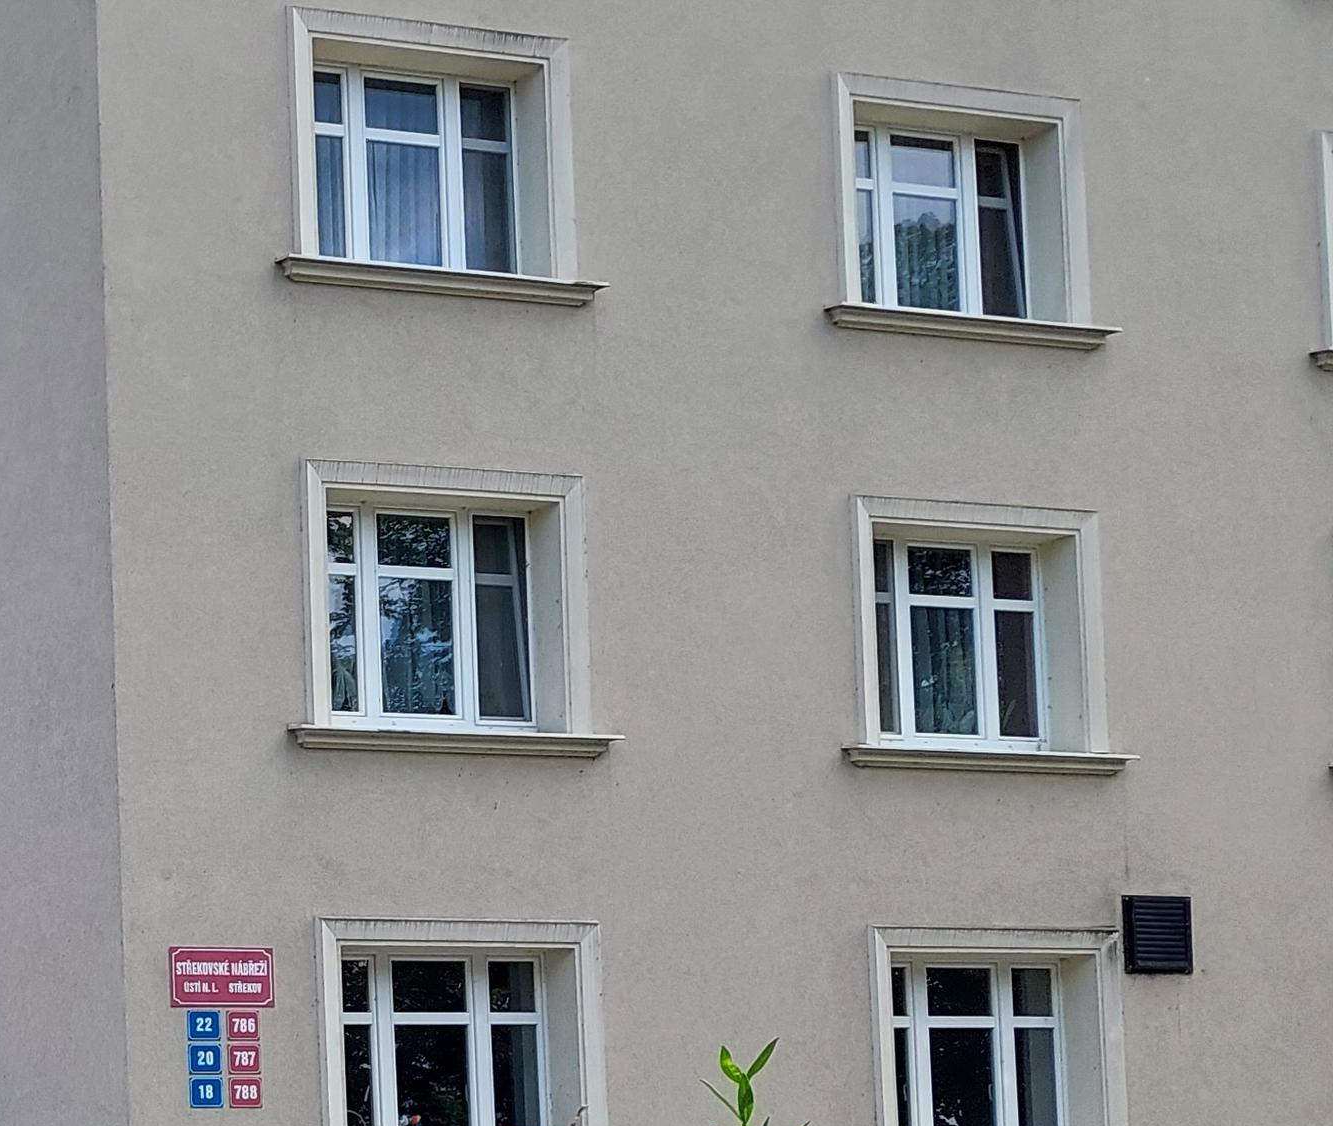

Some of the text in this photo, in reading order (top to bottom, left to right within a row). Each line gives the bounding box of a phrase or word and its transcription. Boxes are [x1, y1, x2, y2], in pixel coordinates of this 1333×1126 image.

[176, 959, 268, 976] STŘEKOVSKÉ NÁBŘEŽÍ
[228, 980, 262, 993] STŘEKOV
[195, 1017, 213, 1032] 22
[232, 1018, 256, 1033] 786
[197, 1051, 214, 1066] 20
[233, 1051, 256, 1067] 787
[198, 1085, 214, 1100] 18
[234, 1085, 258, 1100] 788
